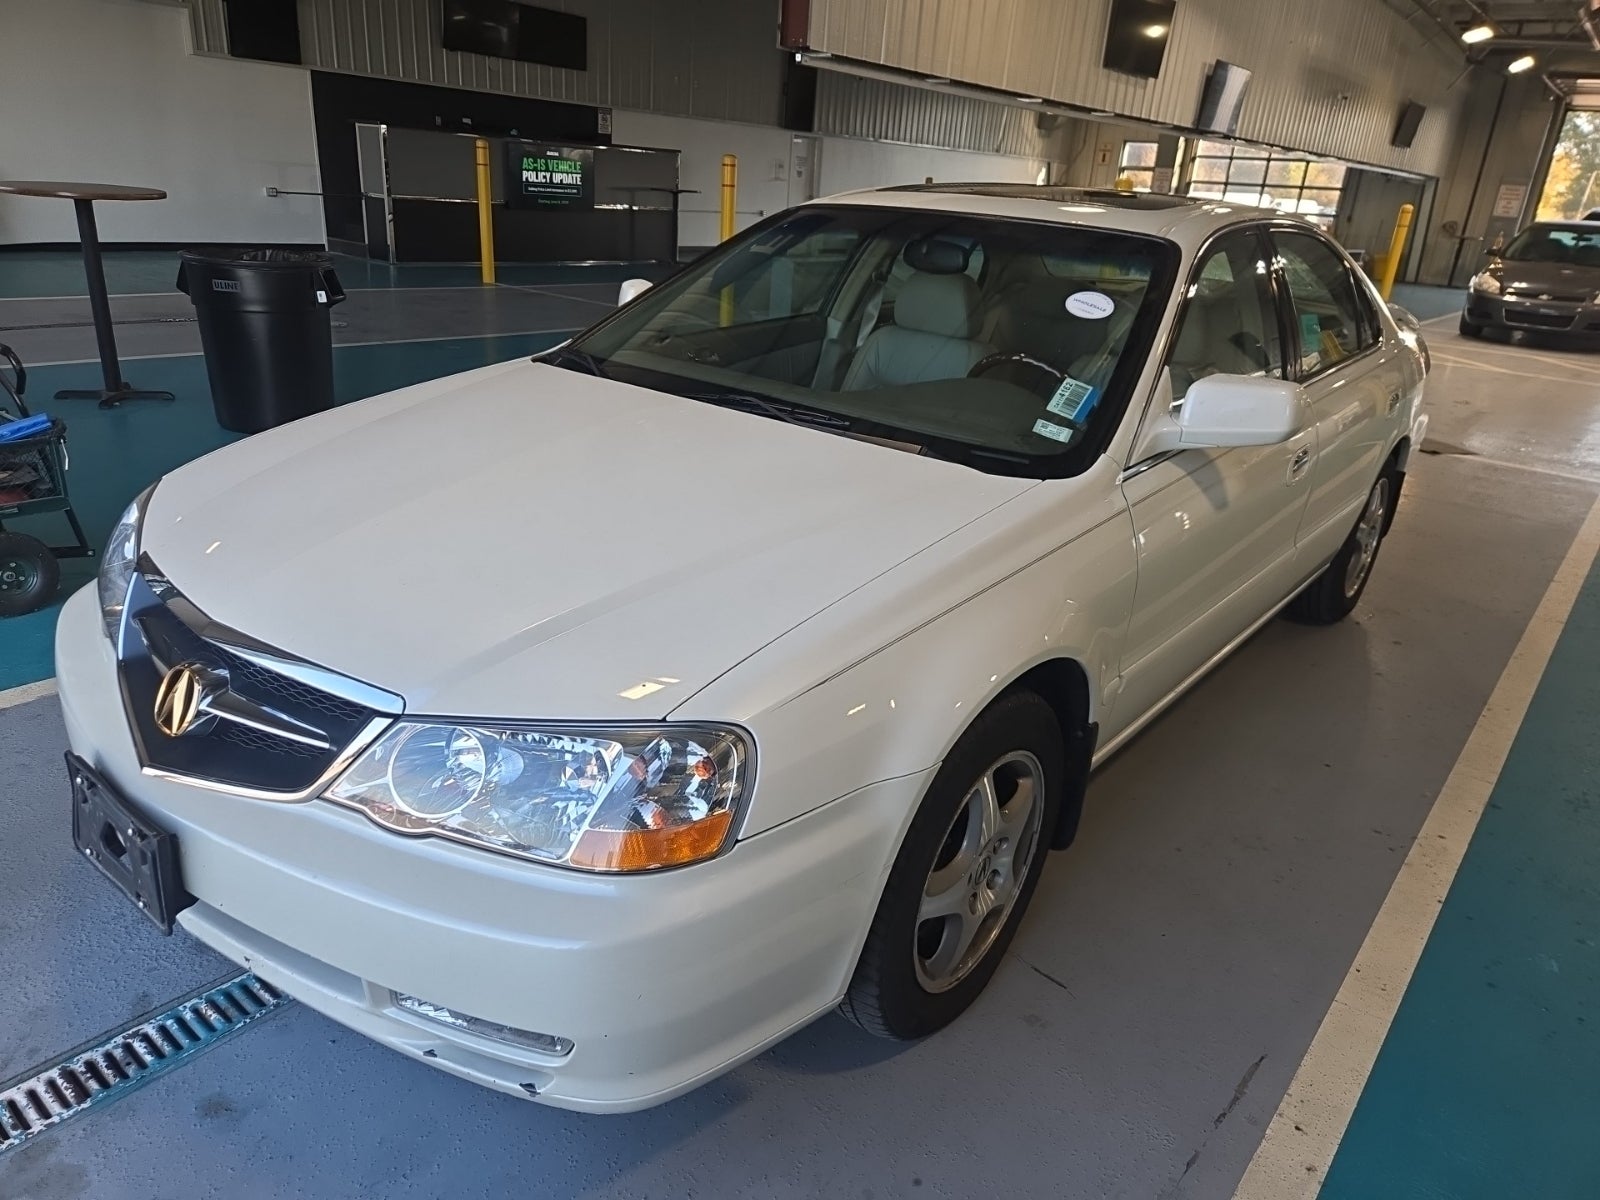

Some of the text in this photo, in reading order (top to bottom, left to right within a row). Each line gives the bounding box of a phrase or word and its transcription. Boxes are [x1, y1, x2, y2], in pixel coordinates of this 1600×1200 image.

[522, 157, 582, 173] AS-IS VEHICLE
[522, 170, 582, 185] POLICY UPDATE
[214, 281, 239, 290] ULINE
